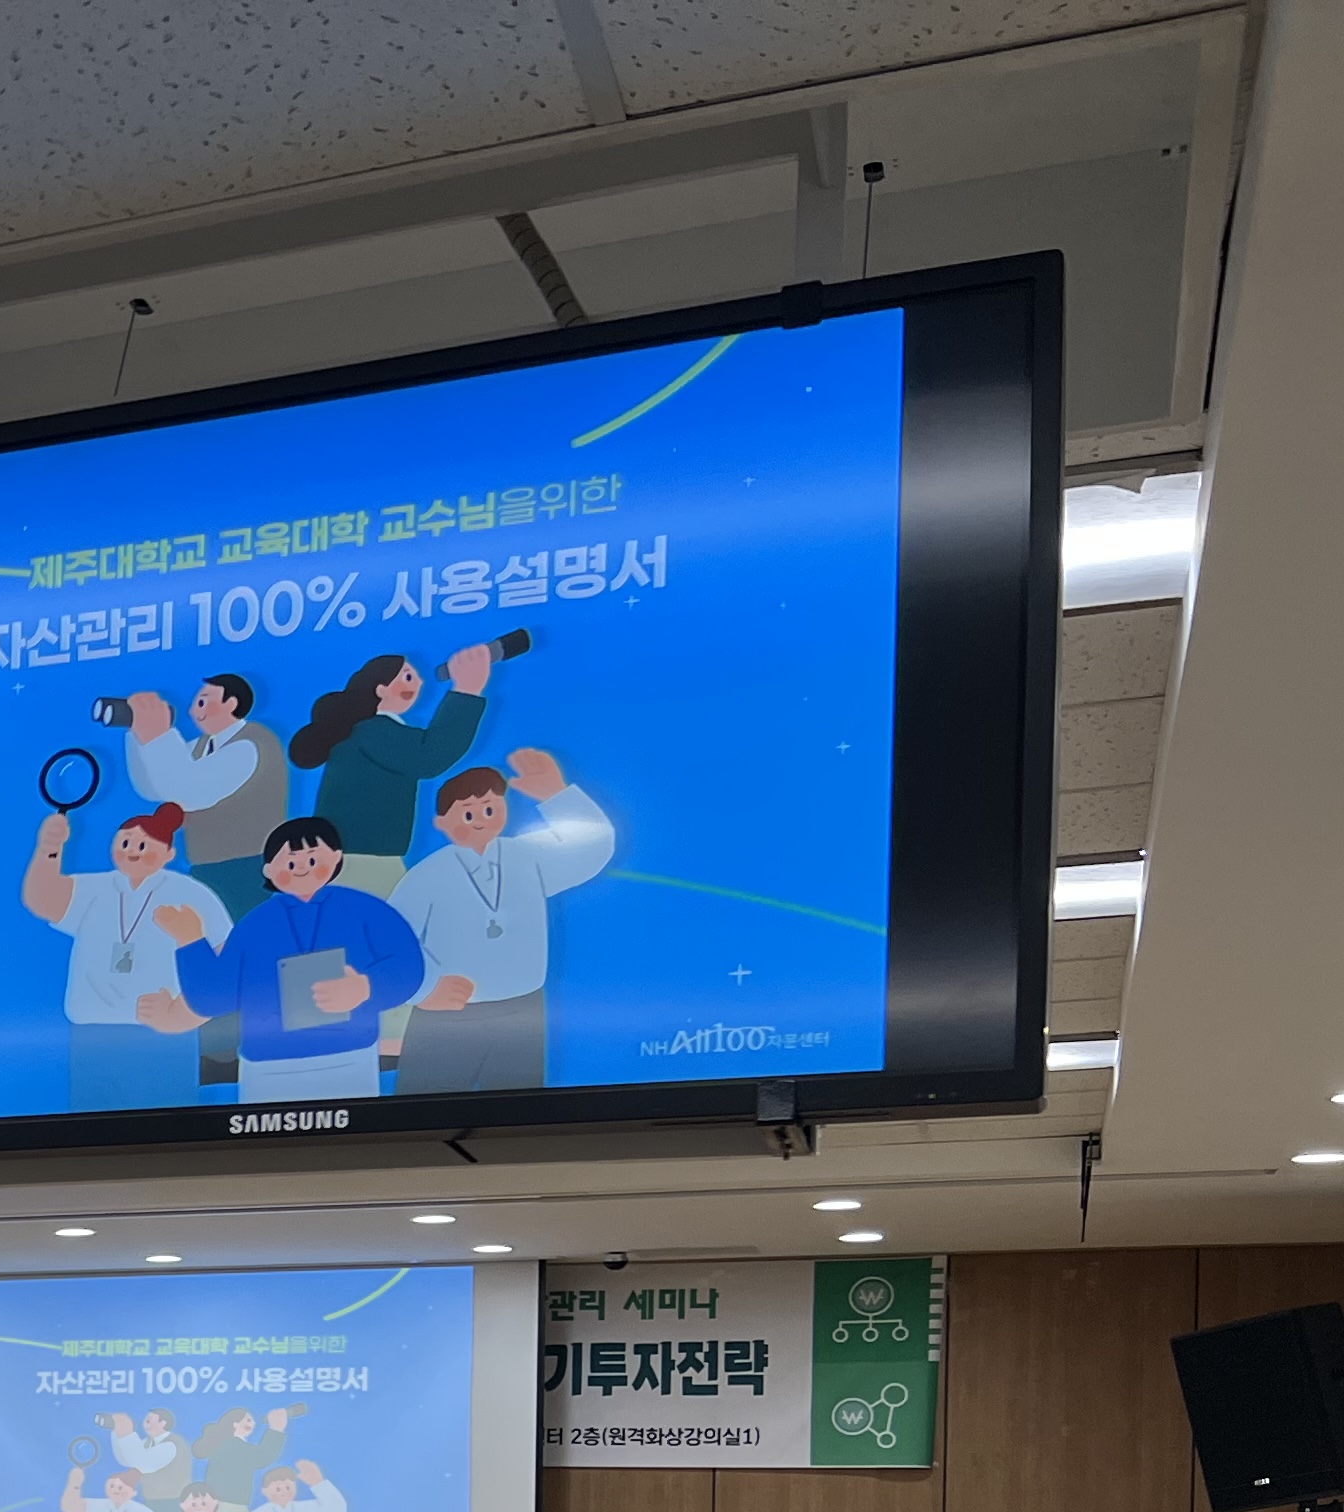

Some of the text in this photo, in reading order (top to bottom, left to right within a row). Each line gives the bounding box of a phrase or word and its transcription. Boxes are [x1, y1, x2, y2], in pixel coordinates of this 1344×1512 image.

[28, 473, 623, 590] 제주대학교 교육대학 교수님을위한
[189, 572, 366, 647] 100%
[382, 535, 668, 622] 사용설명서
[229, 1109, 349, 1135] SAMSUNG
[544, 1288, 720, 1321] 관리 세미나
[62, 1339, 151, 1358] 제주대학교
[156, 1337, 229, 1356] 교육대학
[36, 1366, 369, 1395] 자산관리 100% 사용설명서
[544, 1340, 769, 1396] 기투자전략
